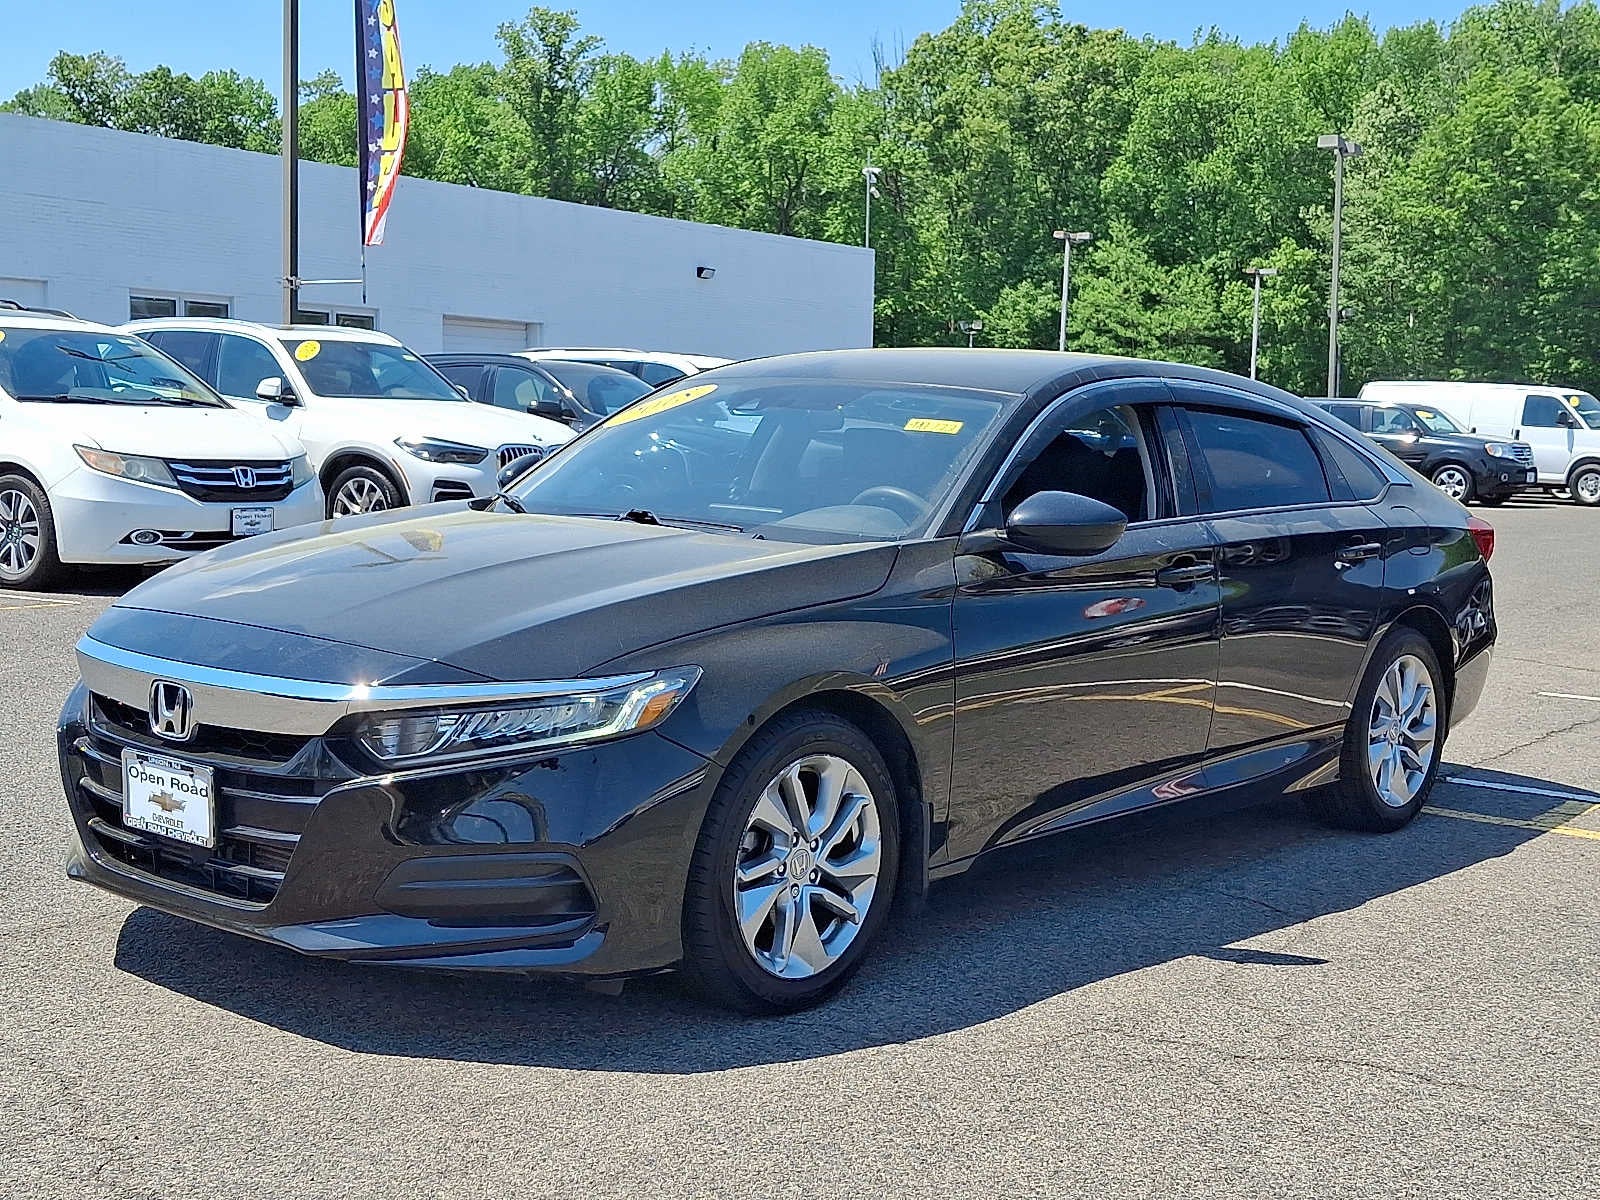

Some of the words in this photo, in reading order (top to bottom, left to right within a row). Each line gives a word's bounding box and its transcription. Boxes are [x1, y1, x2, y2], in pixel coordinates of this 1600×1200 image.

[128, 765, 165, 787] Open
[170, 777, 209, 798] Road
[127, 816, 147, 829] OPEN
[147, 822, 167, 835] ROAD
[167, 828, 208, 846] CHEVROLET
